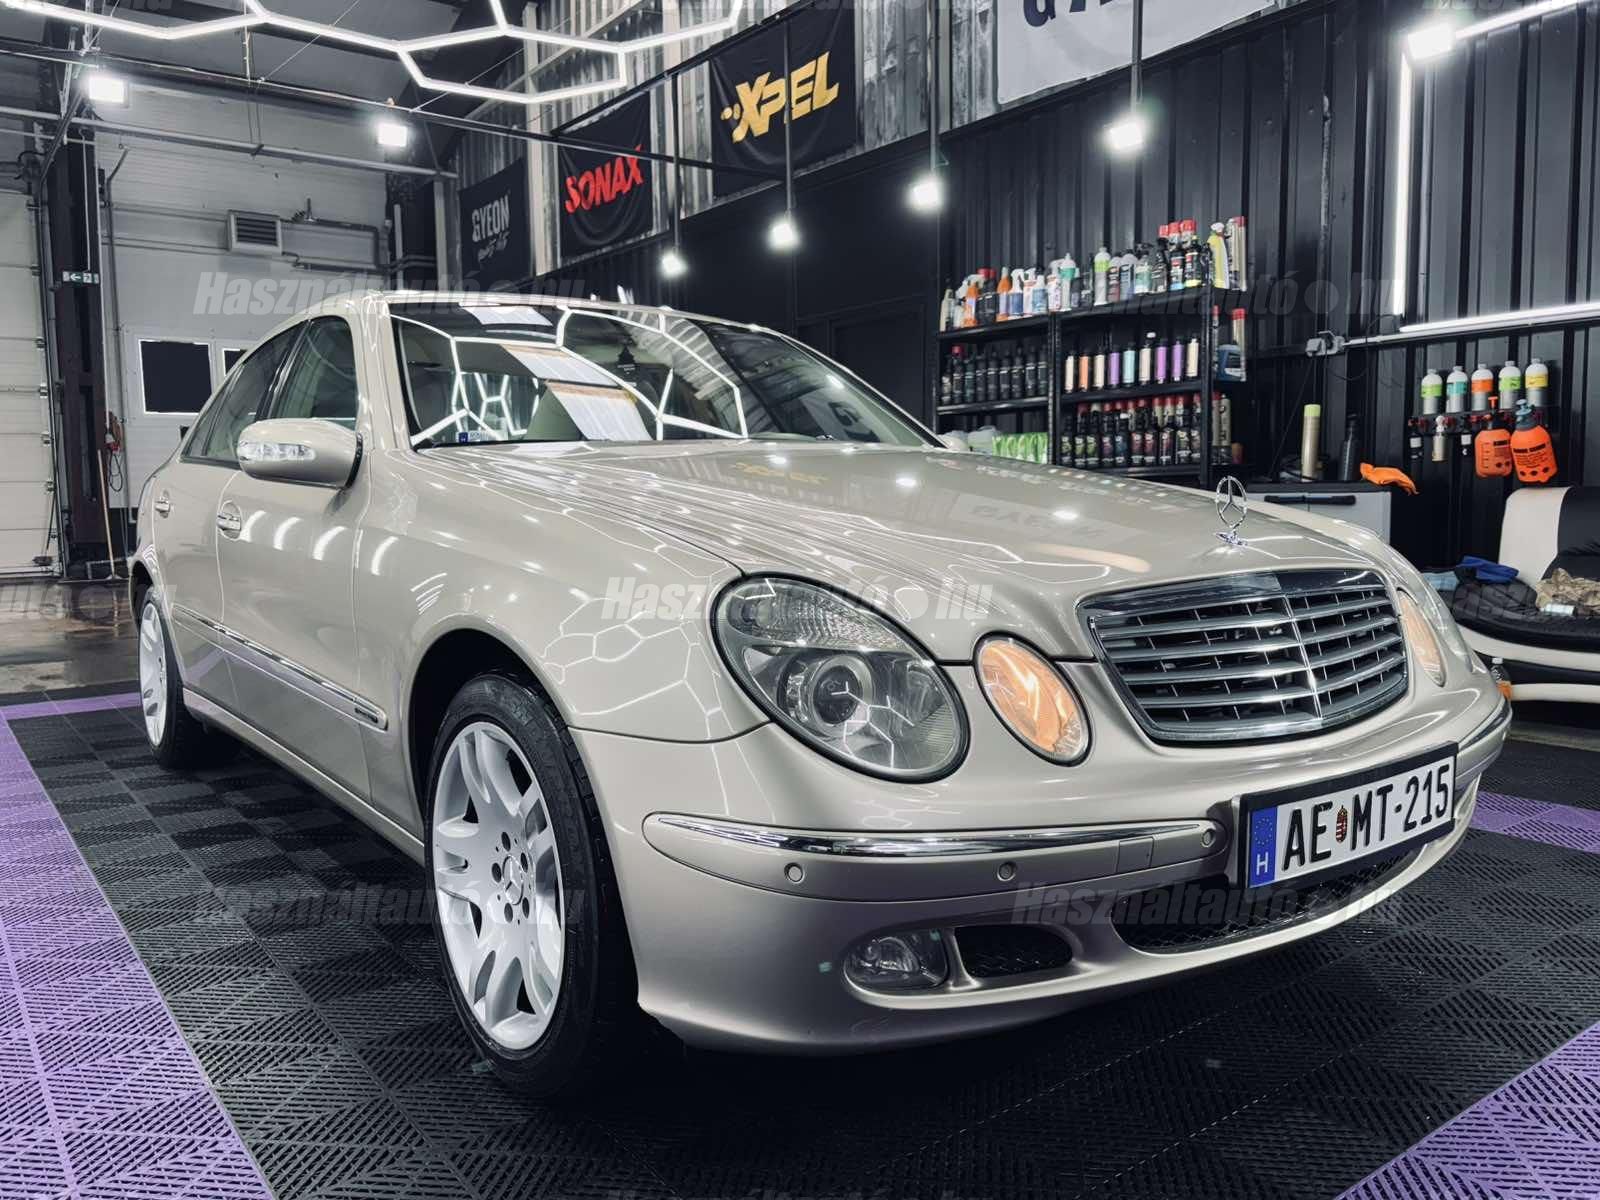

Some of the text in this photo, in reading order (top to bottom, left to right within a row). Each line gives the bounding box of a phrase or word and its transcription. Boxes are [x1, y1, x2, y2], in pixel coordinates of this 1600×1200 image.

[732, 51, 840, 144] XPEL
[565, 143, 645, 213] SONAX
[471, 194, 511, 243] GYEON
[1281, 764, 1450, 871] AE MT-215
[1255, 852, 1270, 876] H
